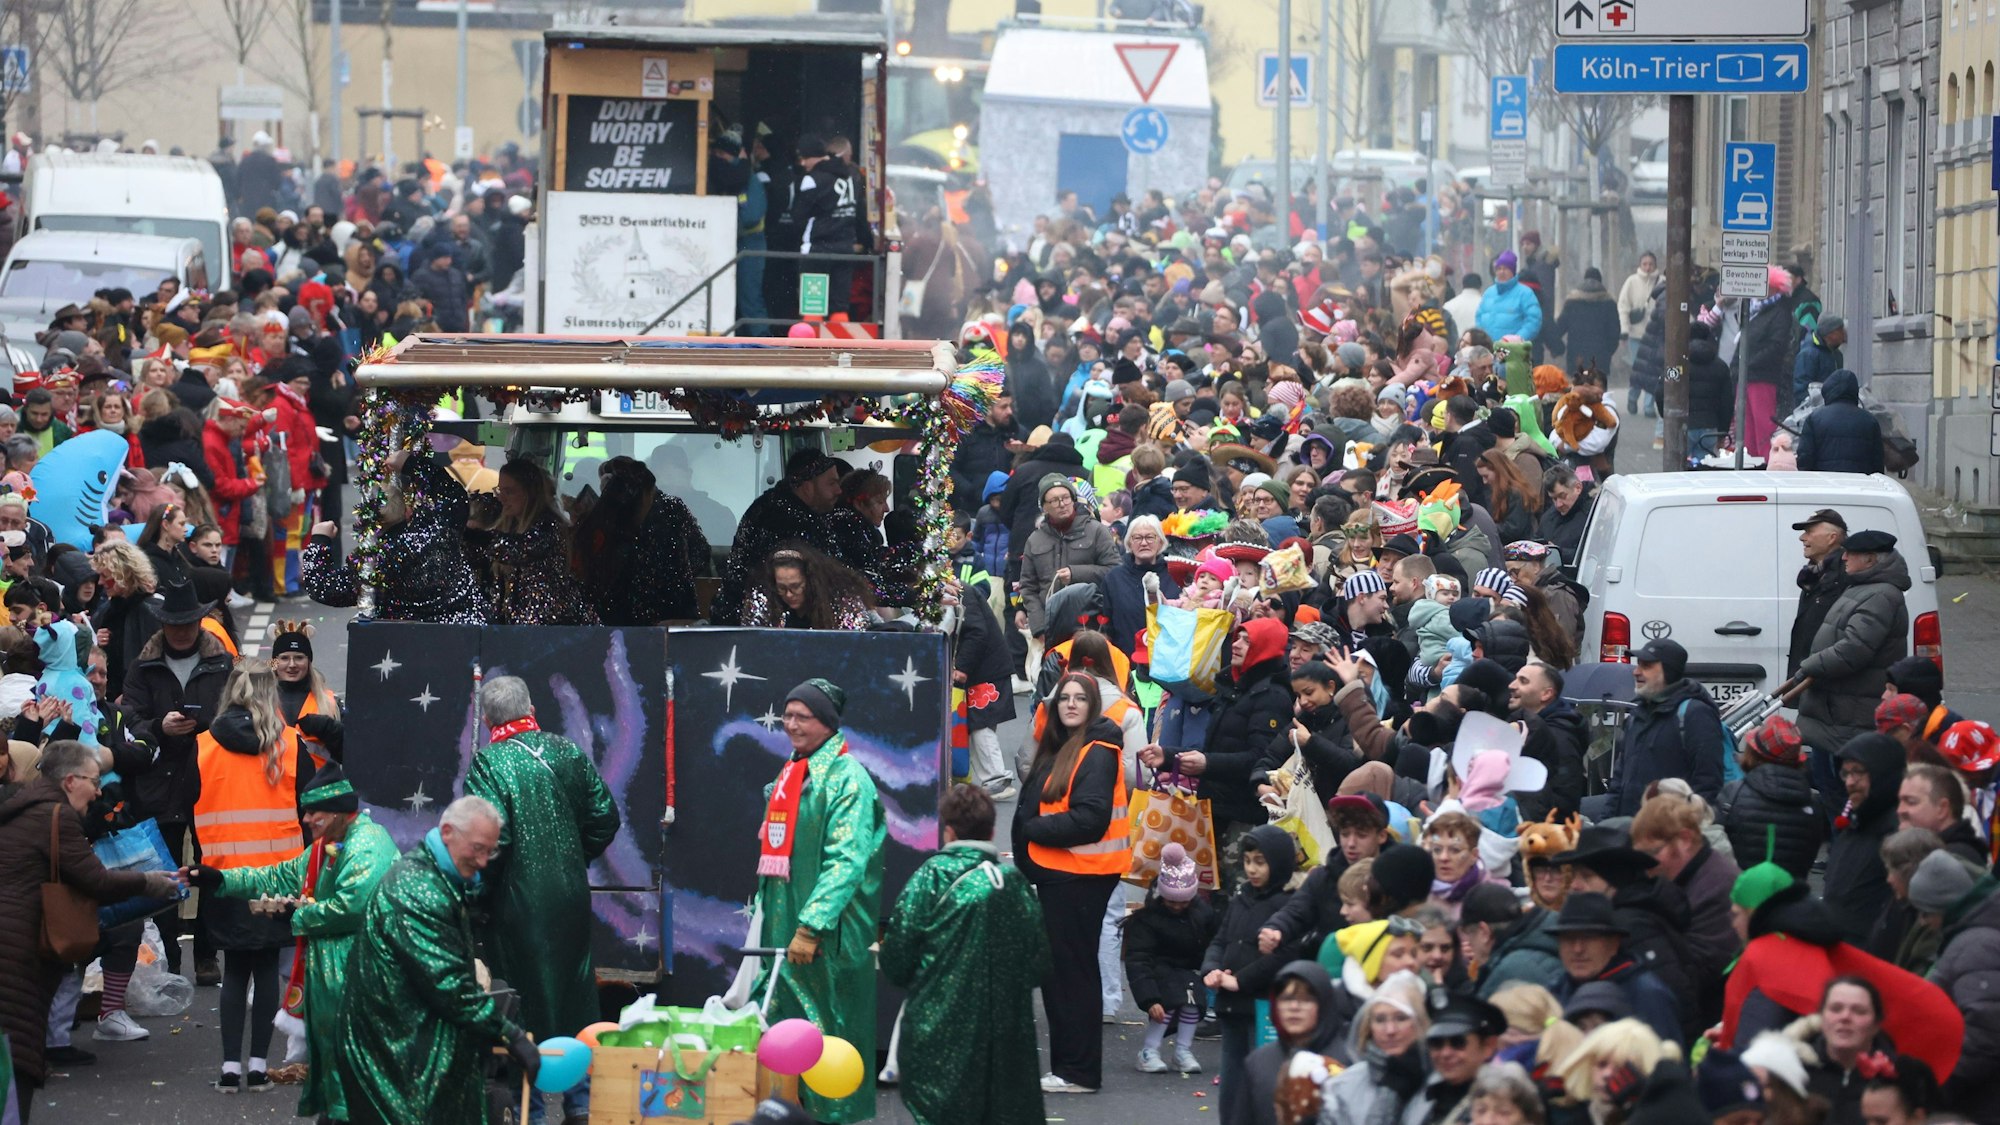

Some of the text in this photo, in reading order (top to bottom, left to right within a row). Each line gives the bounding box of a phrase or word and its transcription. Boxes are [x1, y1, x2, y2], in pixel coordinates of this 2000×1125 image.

[1581, 57, 1711, 79] Köln-Trier
[1496, 79, 1513, 106] P
[598, 101, 668, 121] DON'T
[589, 122, 673, 143] WORRY
[613, 146, 646, 167] BE
[1732, 148, 1754, 183] P
[585, 168, 672, 188] SOFFEN
[833, 176, 857, 207] 21
[1736, 239, 1767, 248] Parkschein
[1723, 250, 1749, 260] werktags
[1725, 270, 1762, 279] Bewohner
